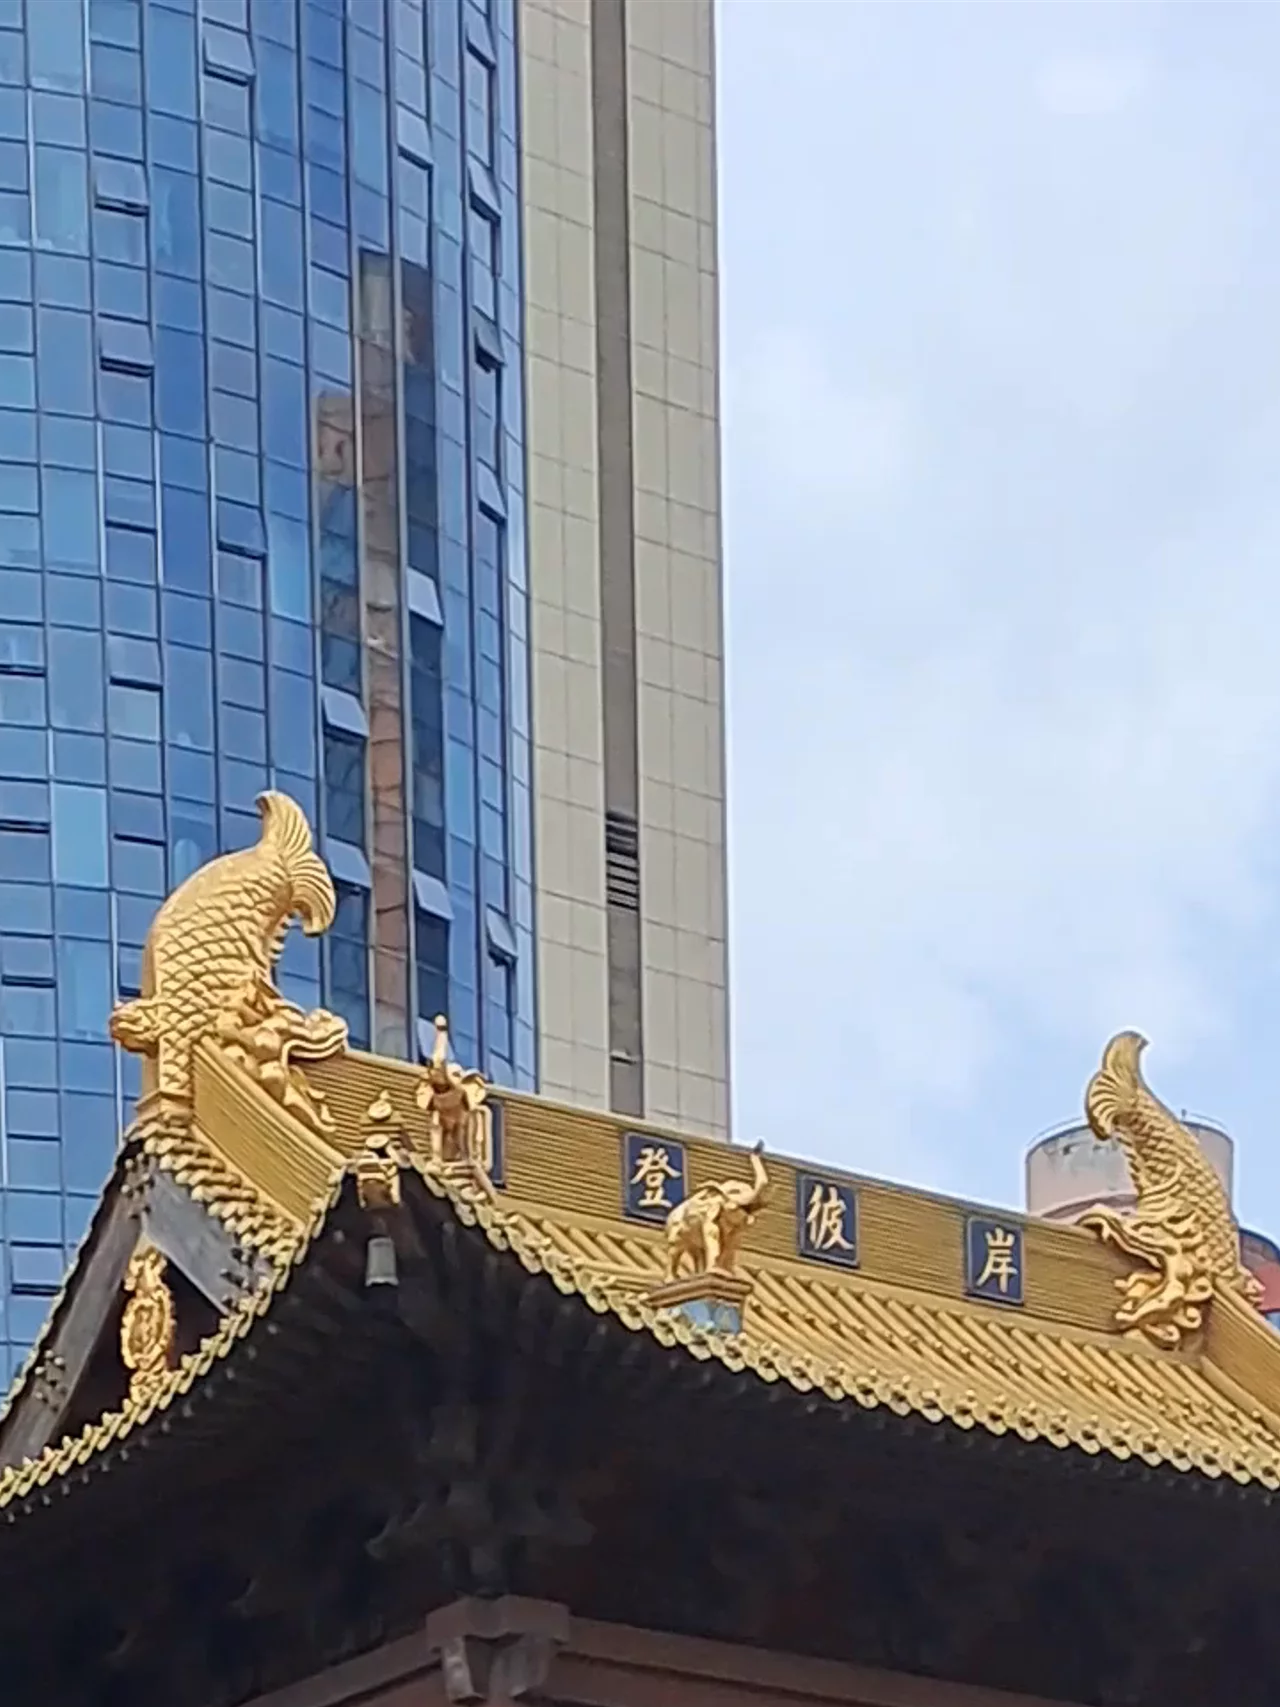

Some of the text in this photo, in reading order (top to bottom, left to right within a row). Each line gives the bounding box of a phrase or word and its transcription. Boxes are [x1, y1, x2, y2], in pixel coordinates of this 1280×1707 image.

[631, 1147, 1019, 1292] 登 彼 岸
